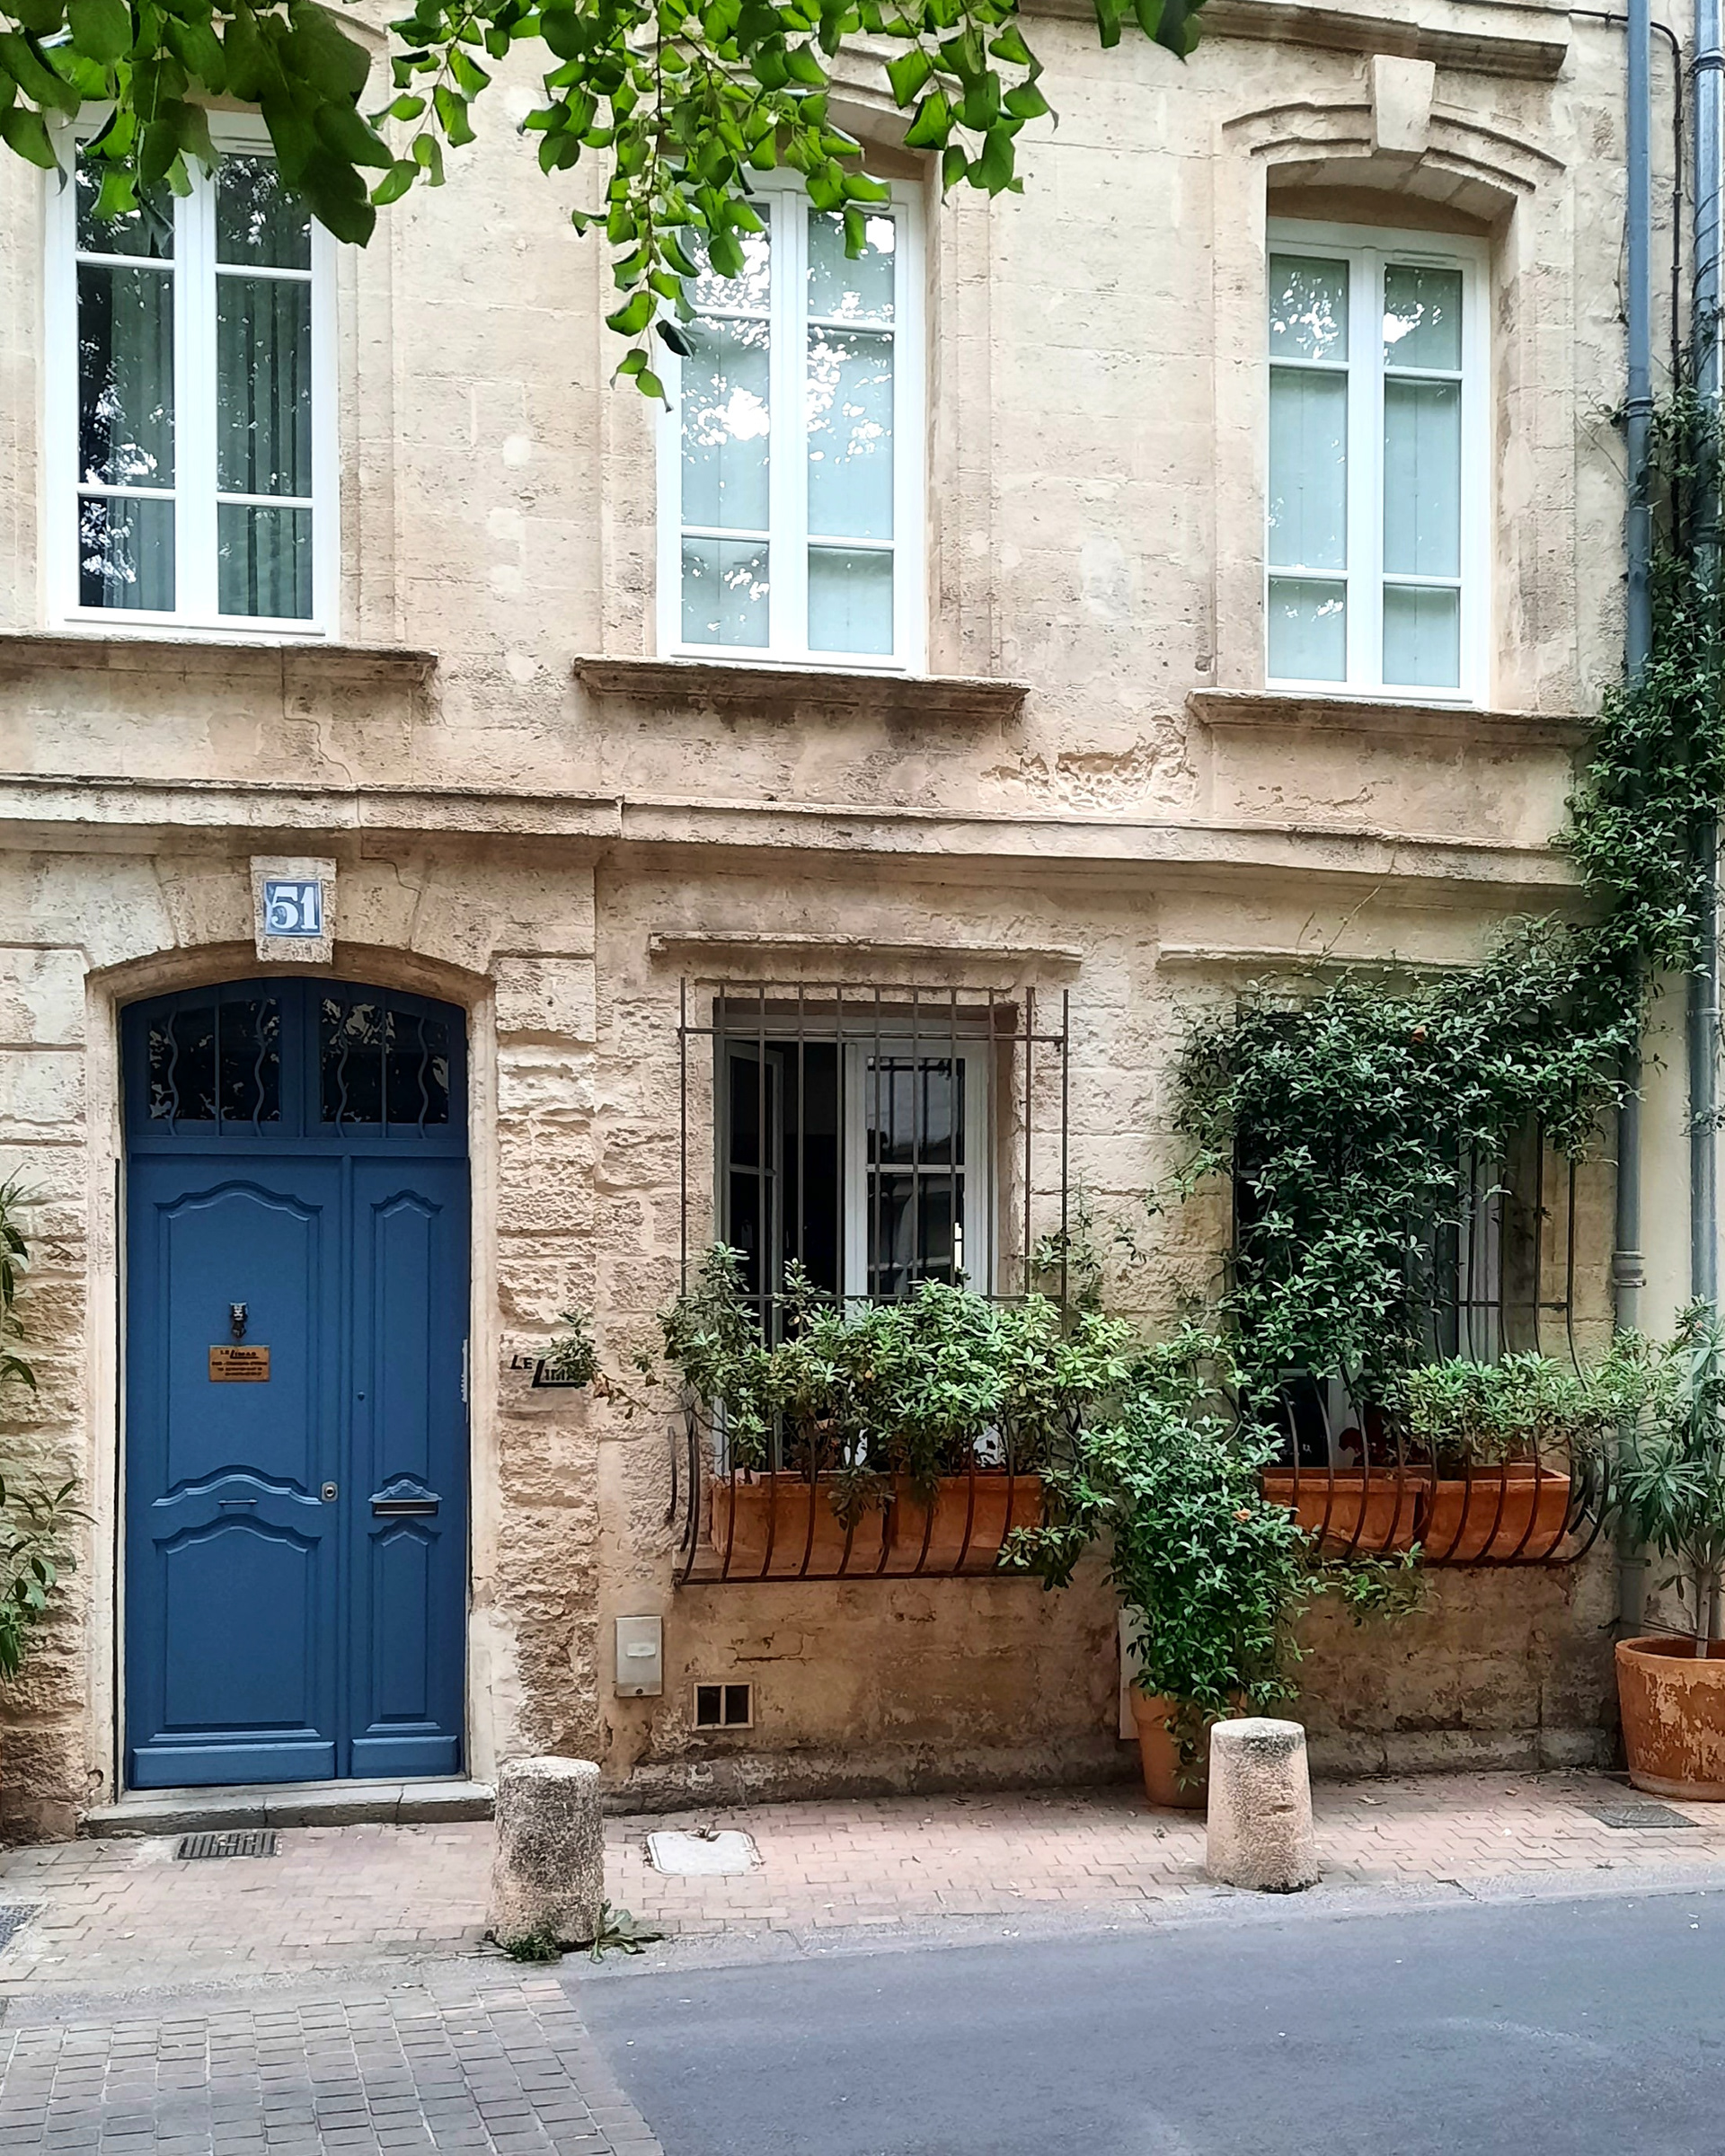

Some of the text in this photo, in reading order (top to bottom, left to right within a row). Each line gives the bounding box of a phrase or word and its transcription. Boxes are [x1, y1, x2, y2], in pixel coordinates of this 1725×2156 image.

[271, 886, 318, 929] 51
[510, 1355, 588, 1389] LE LIM
